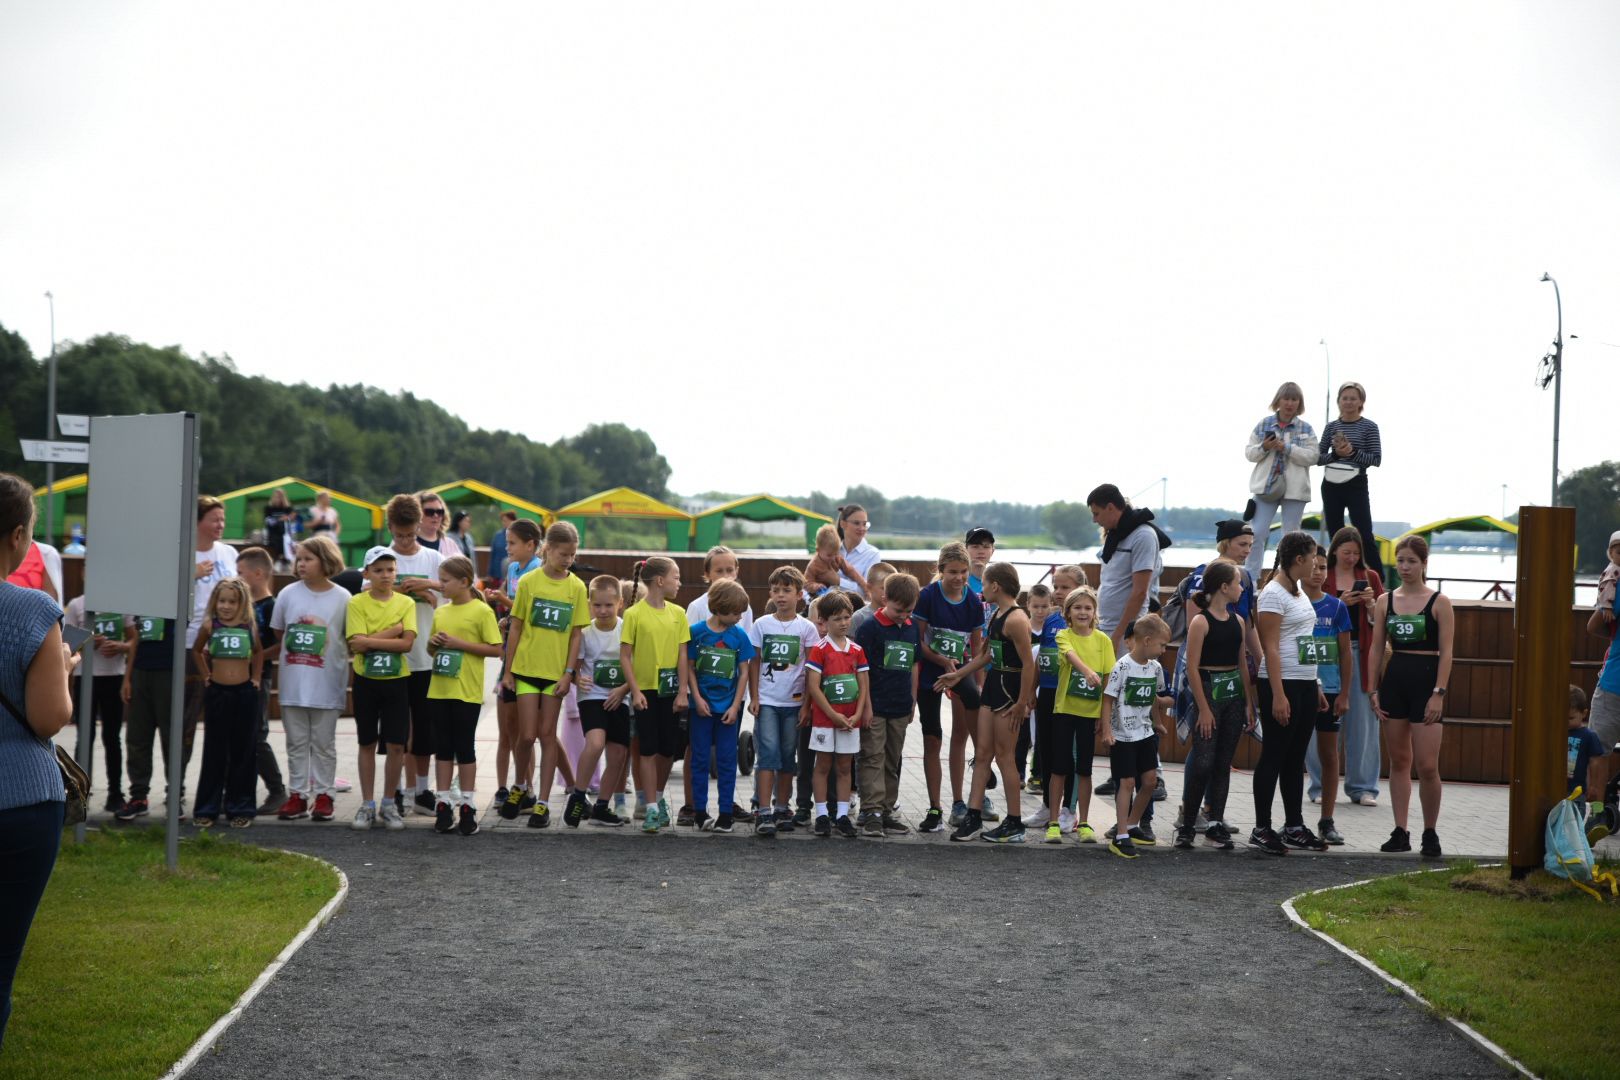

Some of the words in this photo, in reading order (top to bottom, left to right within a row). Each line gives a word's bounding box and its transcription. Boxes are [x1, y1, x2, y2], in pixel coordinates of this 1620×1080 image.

[543, 608, 559, 621] 11
[96, 621, 115, 633] 14
[1396, 623, 1414, 634] 39
[221, 636, 240, 648] 18
[295, 632, 314, 644] 35
[771, 643, 789, 654] 20
[941, 640, 957, 652] 31
[373, 655, 391, 667] 21
[436, 654, 450, 666] 16
[711, 655, 721, 667] 7
[899, 650, 907, 662] 2
[608, 667, 618, 679] 9
[835, 683, 845, 695] 5
[1136, 686, 1152, 697] 40
[1227, 680, 1235, 691] 4
